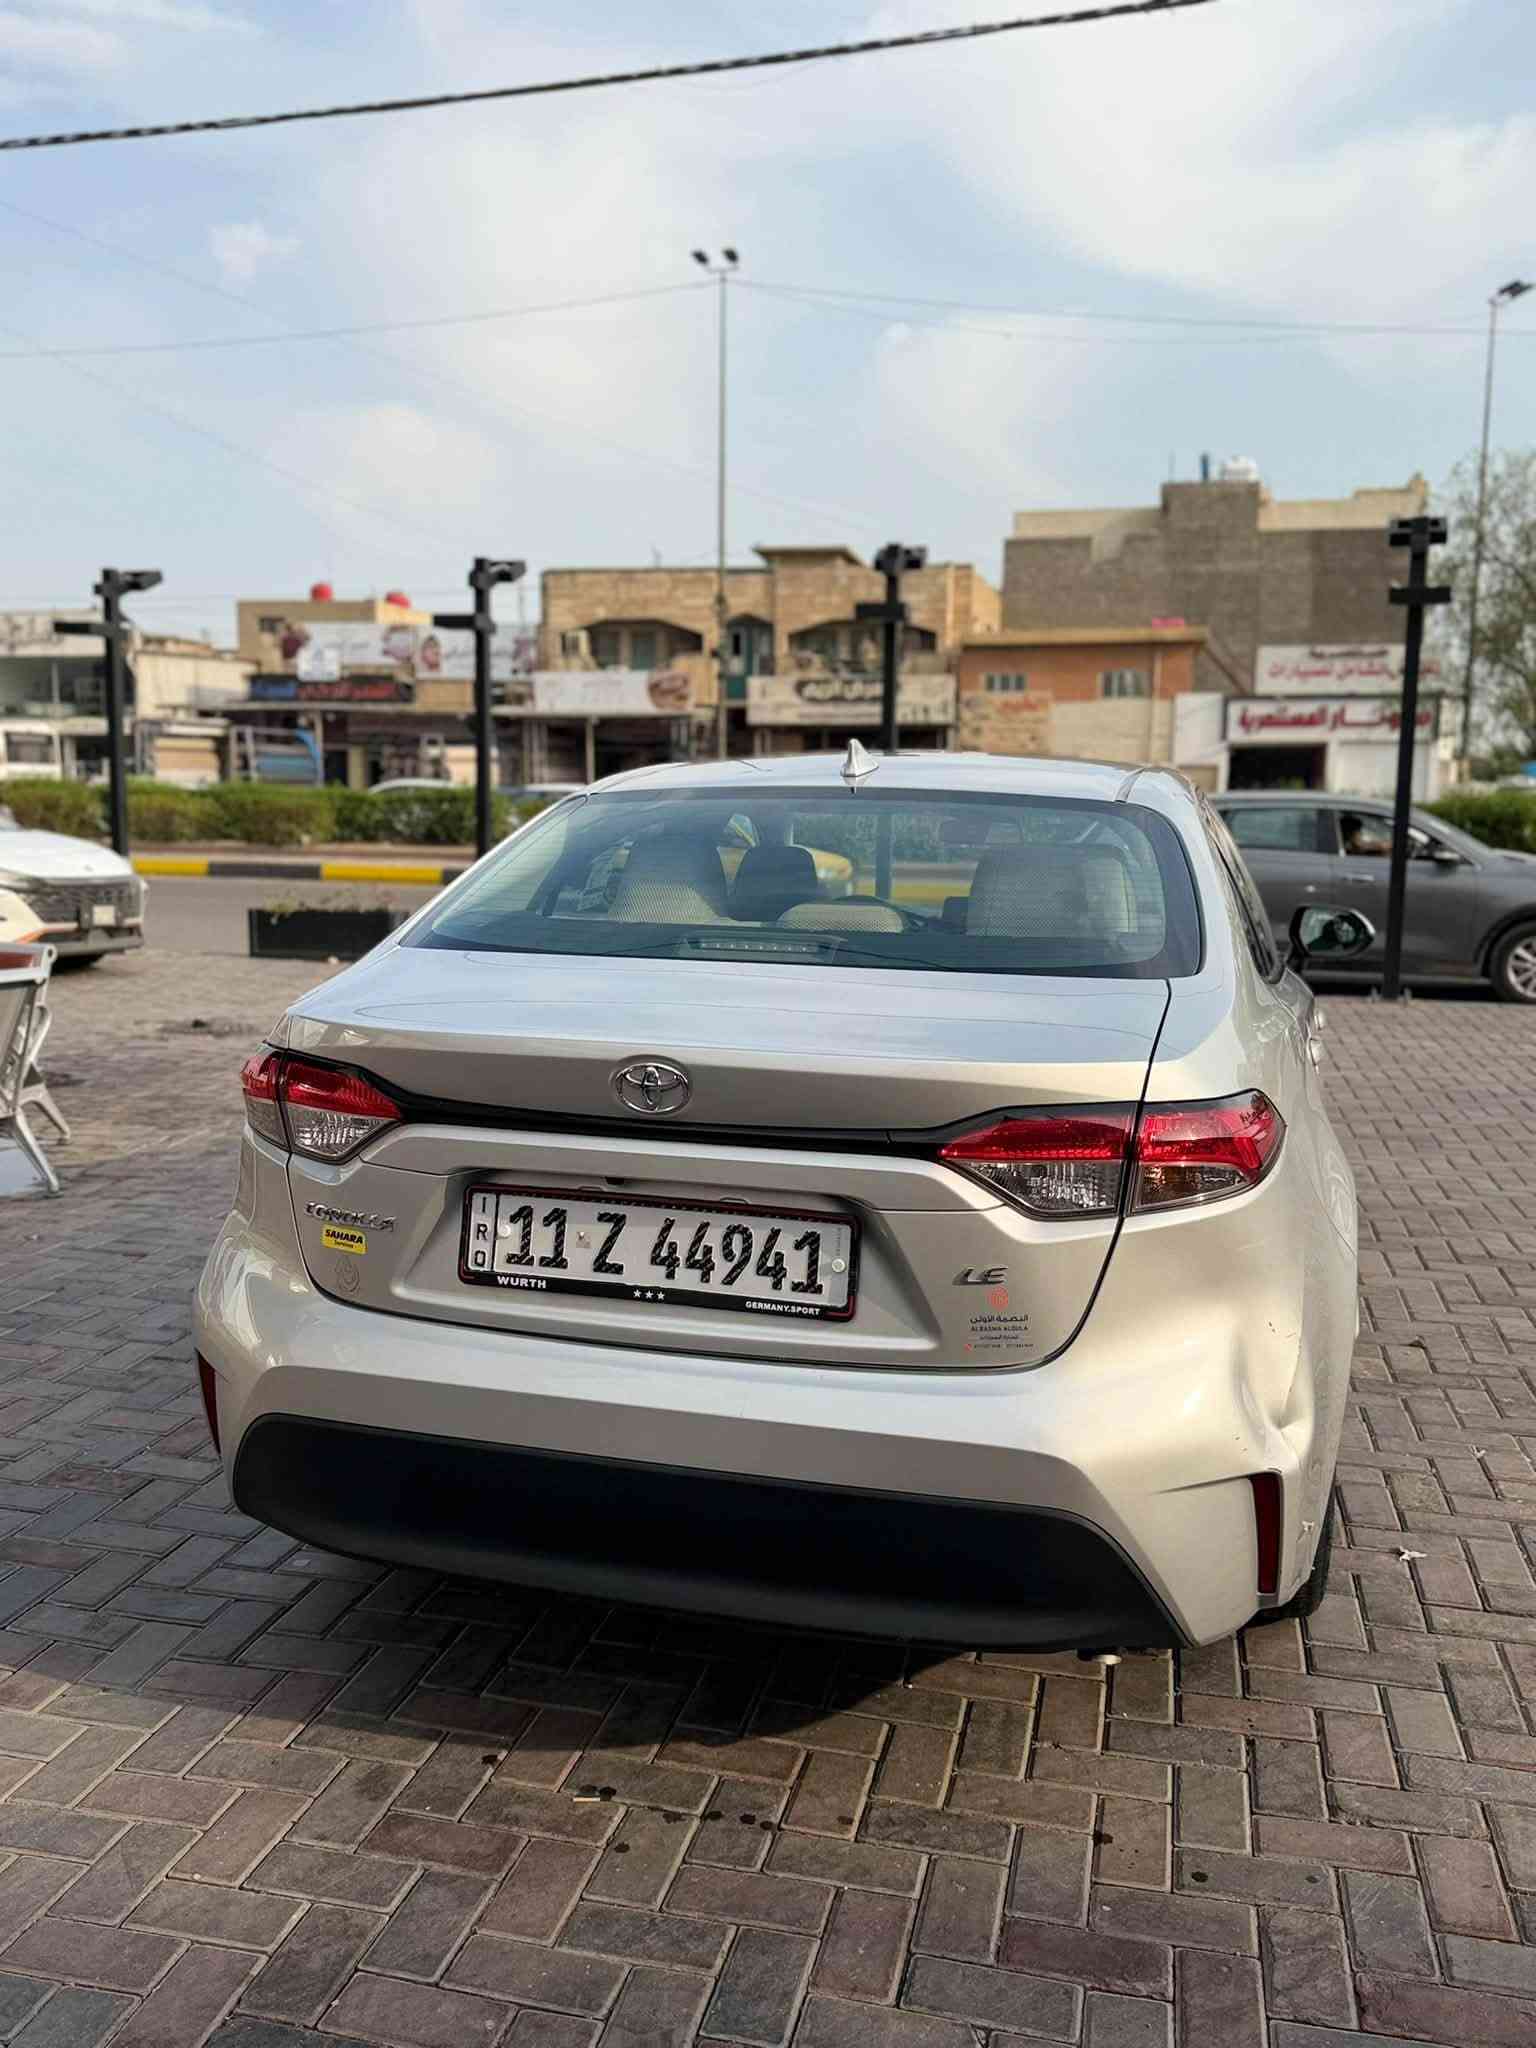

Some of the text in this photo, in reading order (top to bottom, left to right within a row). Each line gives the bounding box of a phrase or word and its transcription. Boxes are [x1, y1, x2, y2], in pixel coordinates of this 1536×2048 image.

[325, 1229, 363, 1244] SAHARA
[506, 1204, 570, 1268] 11
[593, 1211, 628, 1275] Z
[650, 1217, 824, 1294] 44941
[497, 1275, 547, 1289] WURTH
[953, 1266, 1009, 1286] LE
